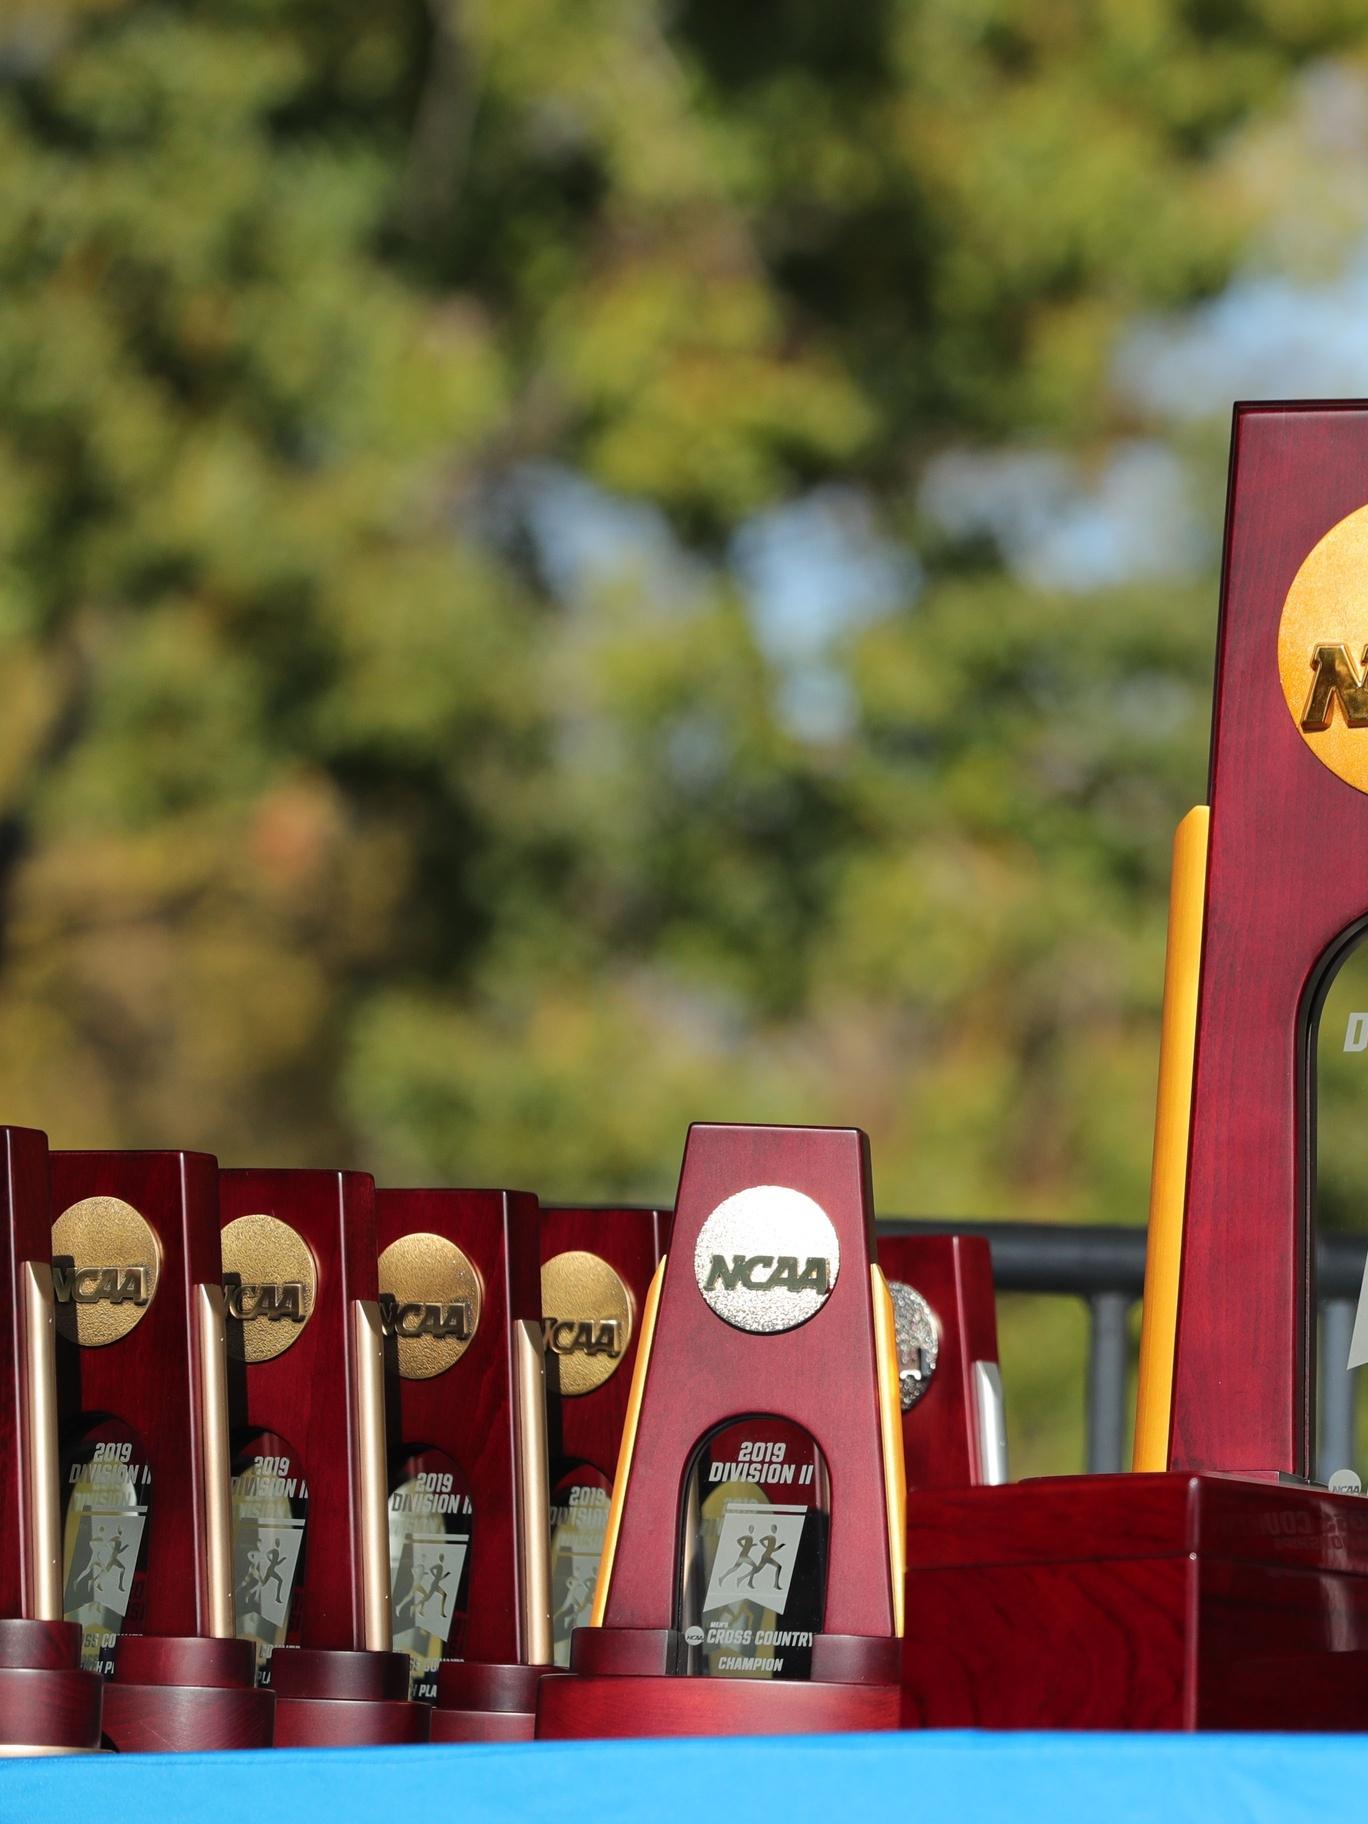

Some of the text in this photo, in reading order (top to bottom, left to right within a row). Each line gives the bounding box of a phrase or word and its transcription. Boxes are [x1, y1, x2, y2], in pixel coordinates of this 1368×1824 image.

[703, 1254, 829, 1295] NCAA
[224, 1284, 305, 1321] CAA
[93, 1442, 132, 1463] 2019
[738, 1441, 787, 1463] 2019
[68, 1463, 140, 1485] DIVISION
[253, 1456, 290, 1477] 2019
[708, 1462, 814, 1485] DIVISION II
[416, 1472, 453, 1493] 2019
[391, 1492, 460, 1514] DIVISION
[706, 1629, 752, 1646] CROSS
[718, 1656, 784, 1672] CHAMPION
